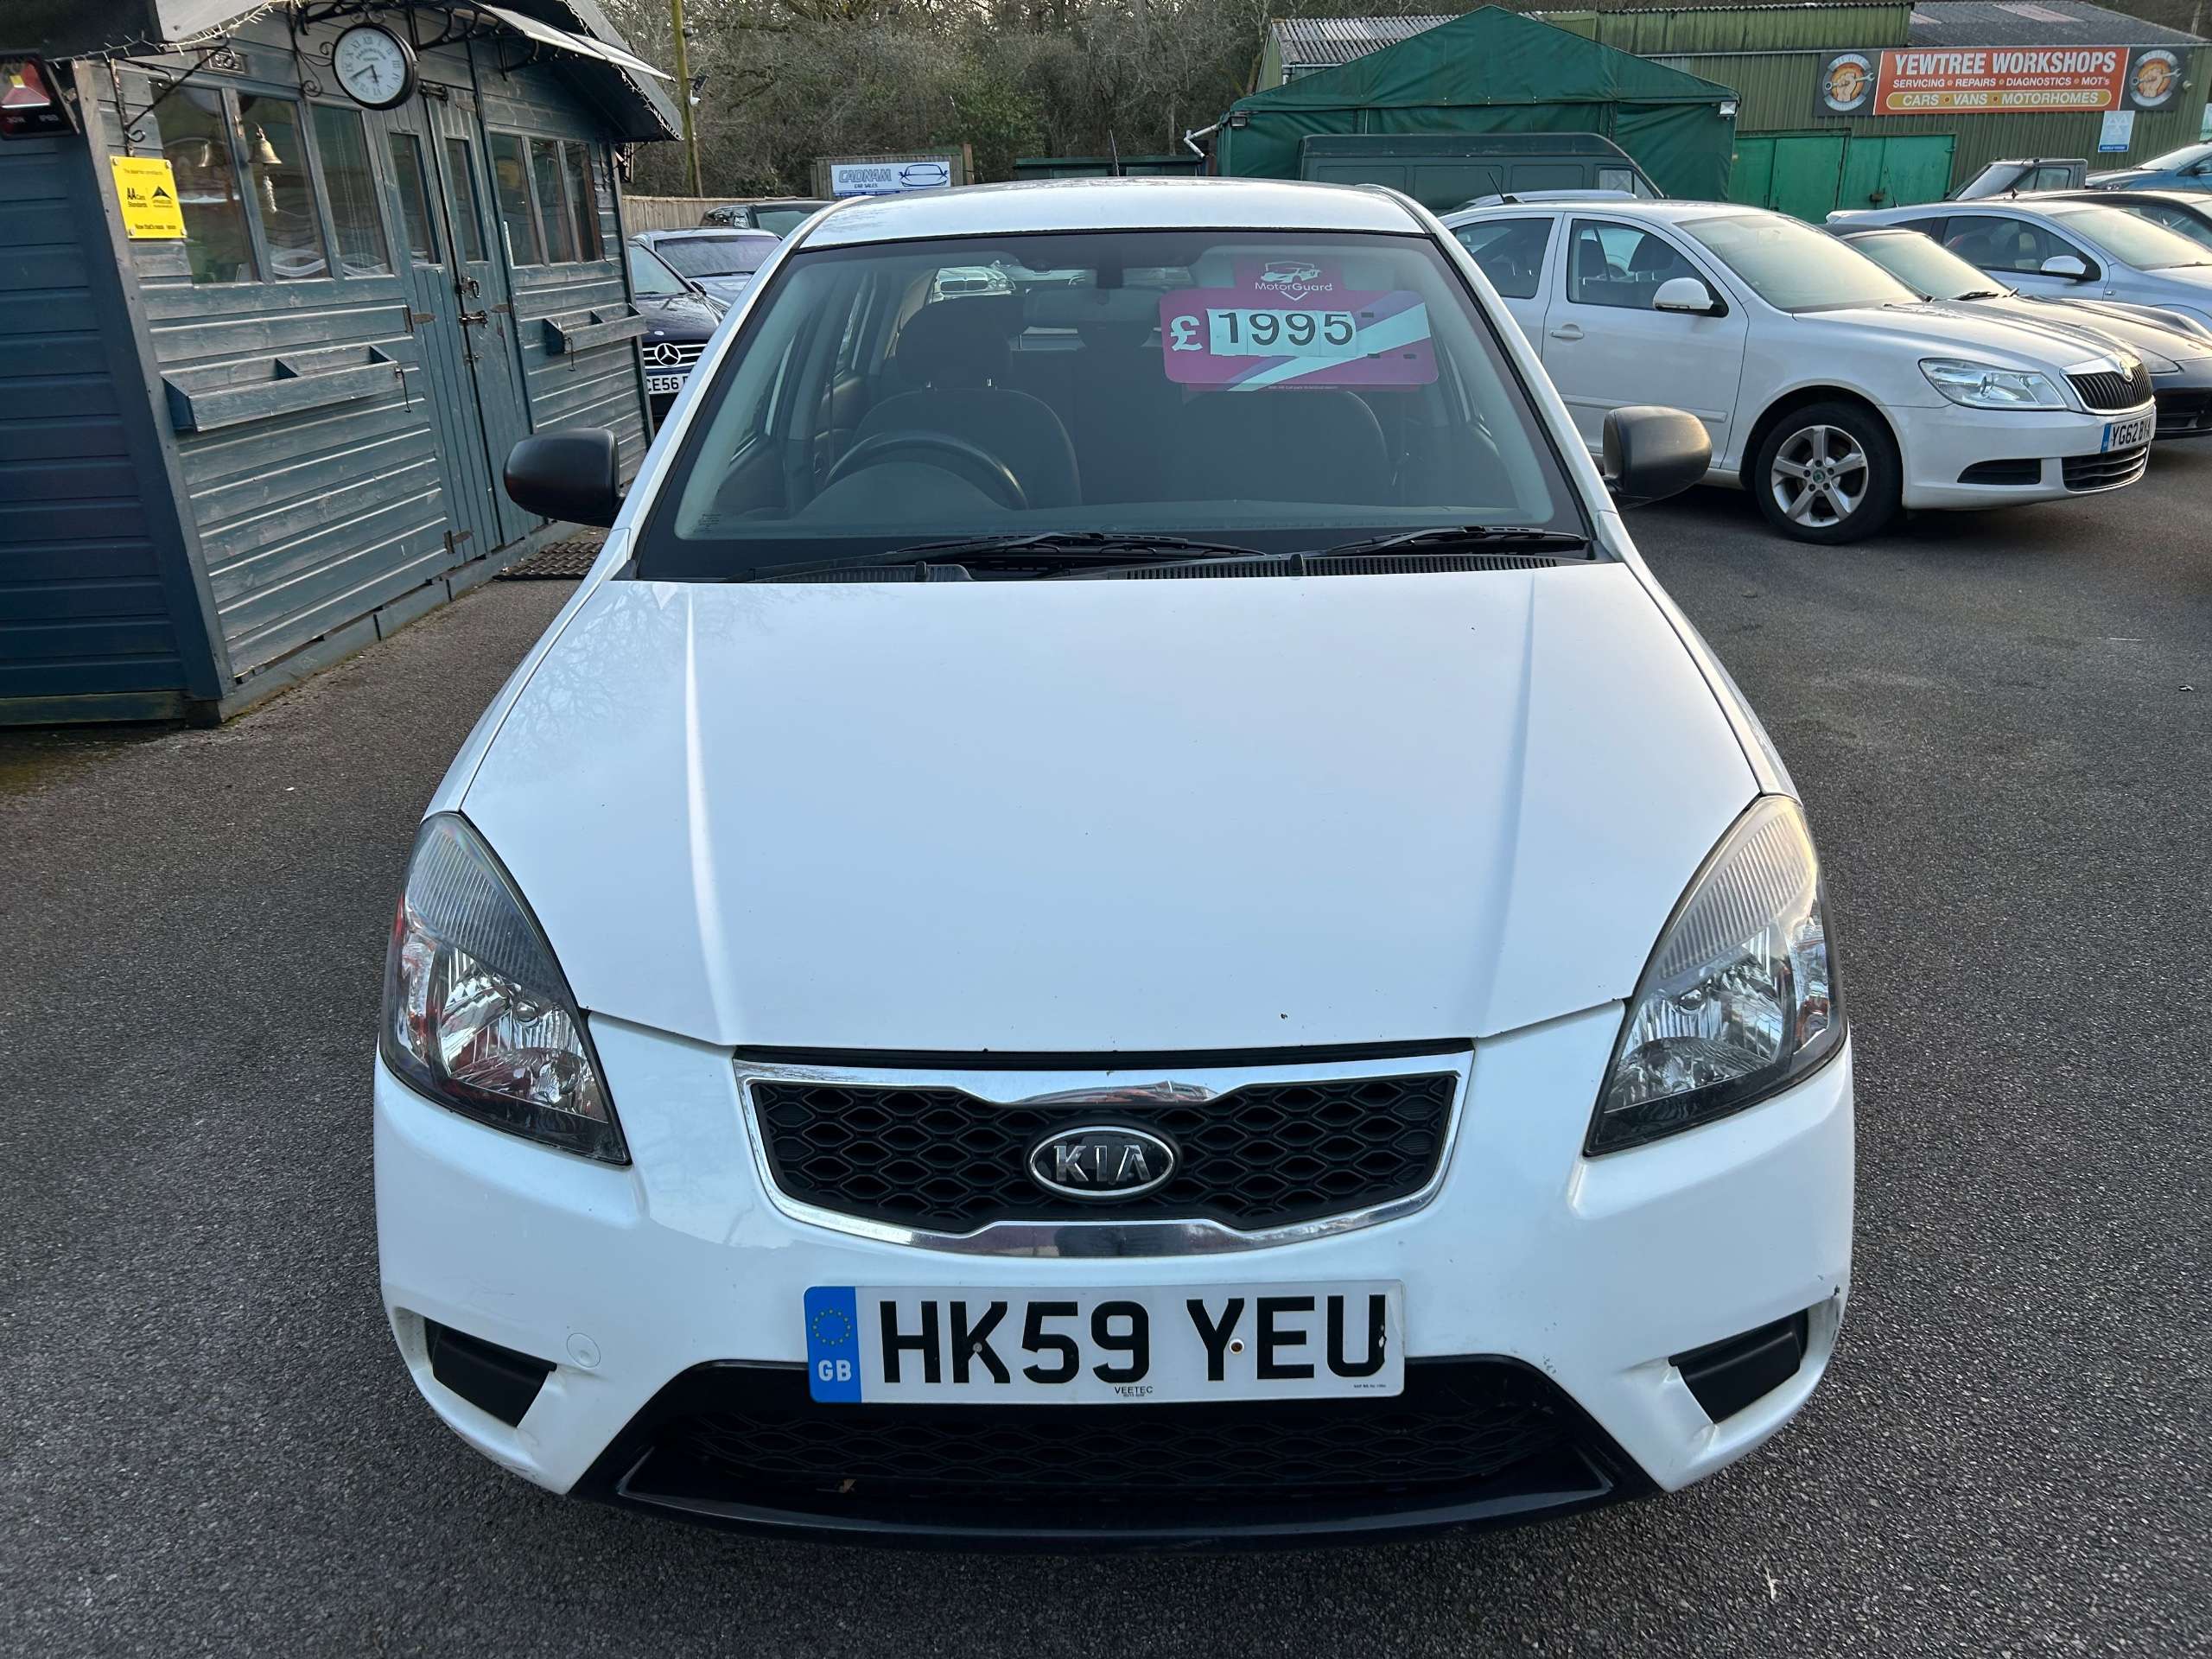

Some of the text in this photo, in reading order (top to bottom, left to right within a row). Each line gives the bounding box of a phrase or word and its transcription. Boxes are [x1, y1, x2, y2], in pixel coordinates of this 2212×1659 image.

[1895, 53, 1986, 75] YEWTREE
[1993, 51, 2116, 73] WORKSHOPS
[1893, 76, 2110, 88] SERVICING REPAIRS DIAGNOSTICS MOT's
[1903, 92, 2099, 106] CARS VANS MOTORHOMES
[839, 168, 892, 182] CADNAM
[1255, 282, 1333, 291] MotorGuard
[2113, 423, 2139, 447] YG62
[1054, 1145, 1152, 1182] KIA
[880, 1294, 1387, 1384] HK59 YEU
[818, 1359, 852, 1382] GB
[1115, 1386, 1154, 1395] VEETEC
